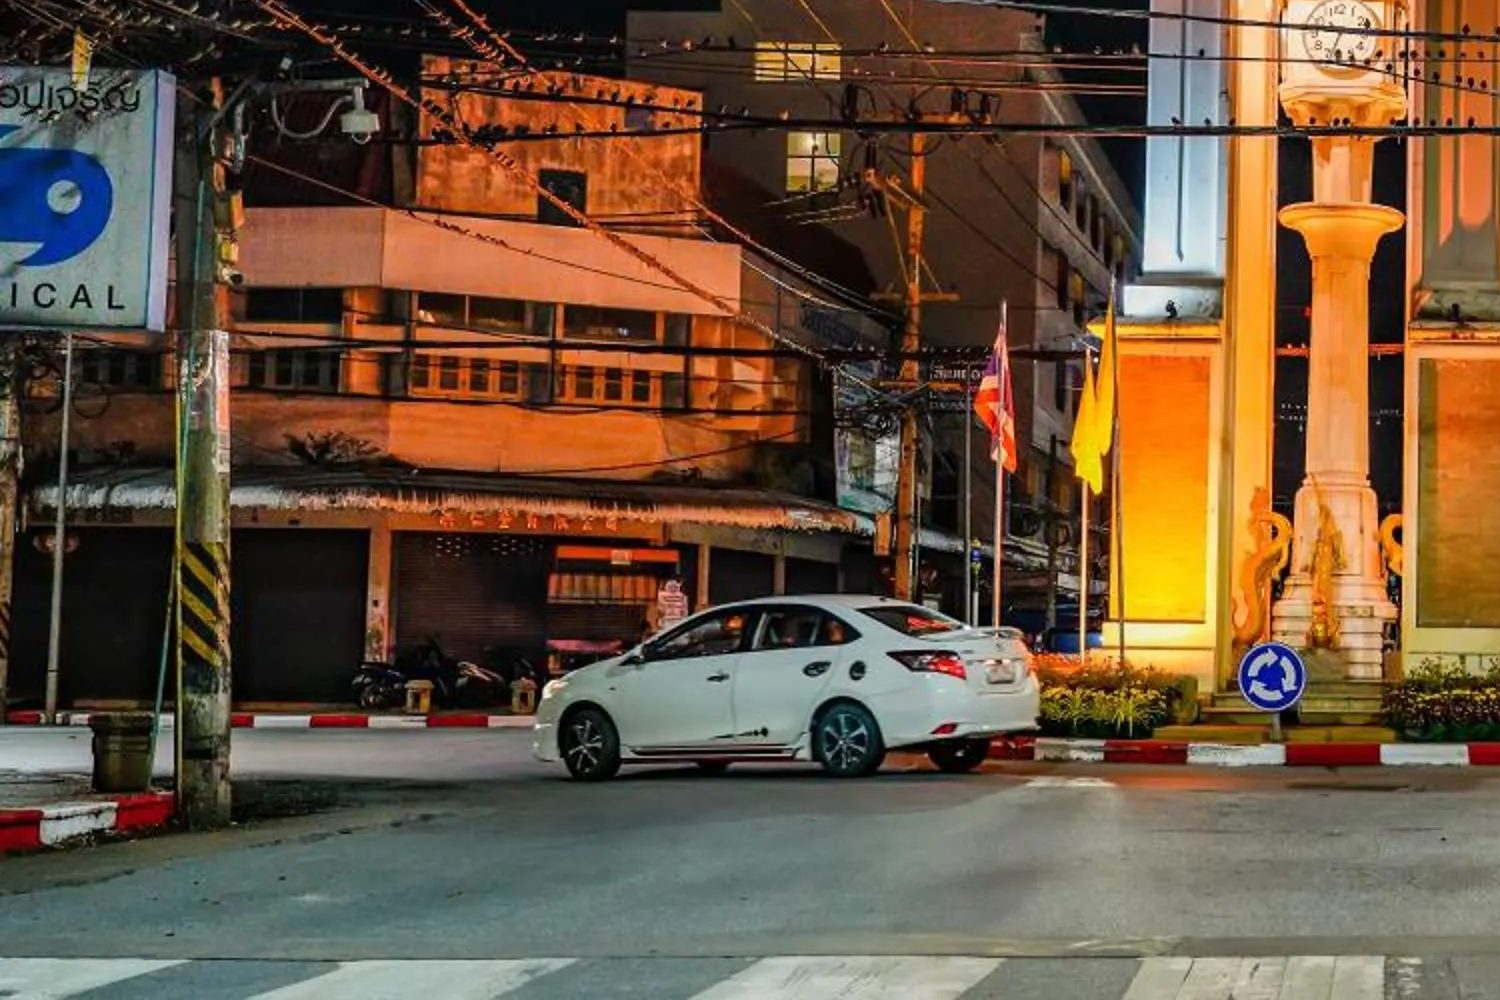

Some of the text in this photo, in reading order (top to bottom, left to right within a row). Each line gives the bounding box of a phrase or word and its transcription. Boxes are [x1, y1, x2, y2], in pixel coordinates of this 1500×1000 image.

[1334, 3, 1346, 15] 12
[1314, 40, 1323, 51] 8
[11, 282, 126, 310] ICAL
